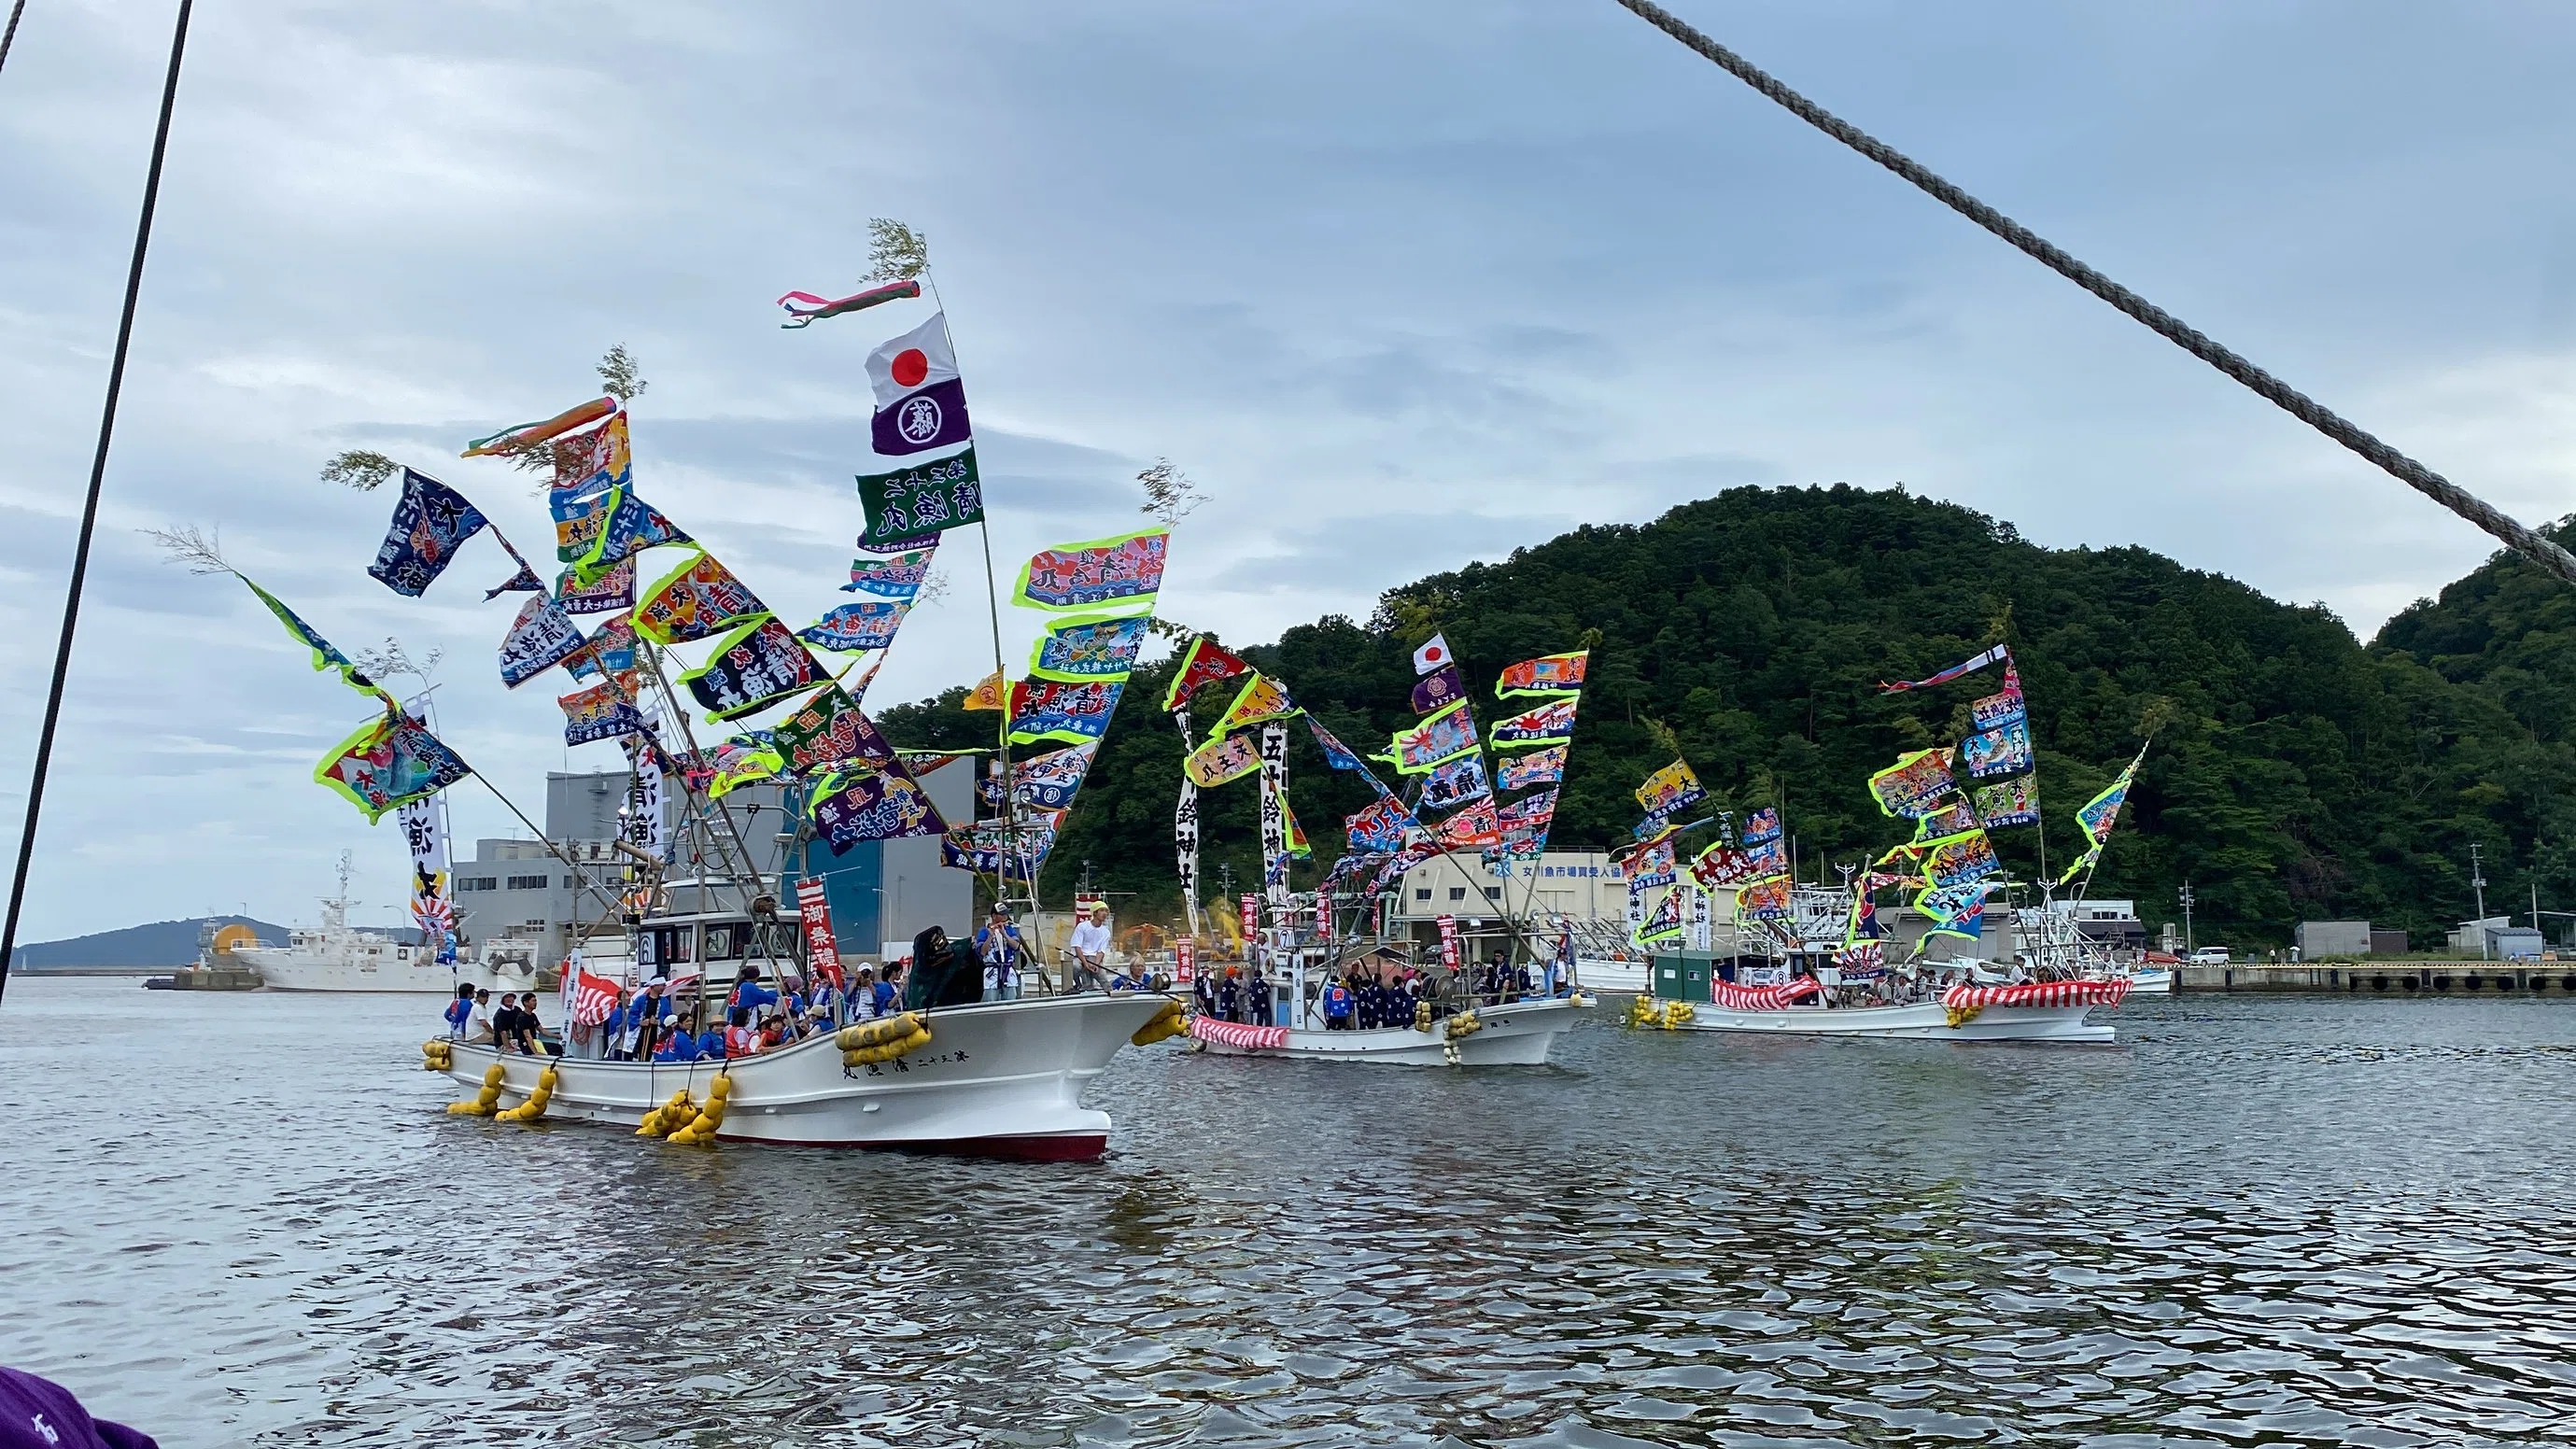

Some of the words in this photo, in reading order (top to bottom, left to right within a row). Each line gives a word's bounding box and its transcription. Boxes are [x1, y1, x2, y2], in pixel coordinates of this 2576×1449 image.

[1262, 735, 1285, 886] 五十鈴神
[1523, 866, 1626, 878] 女川魚市場買受人協
[805, 904, 838, 968] 御祭禮
